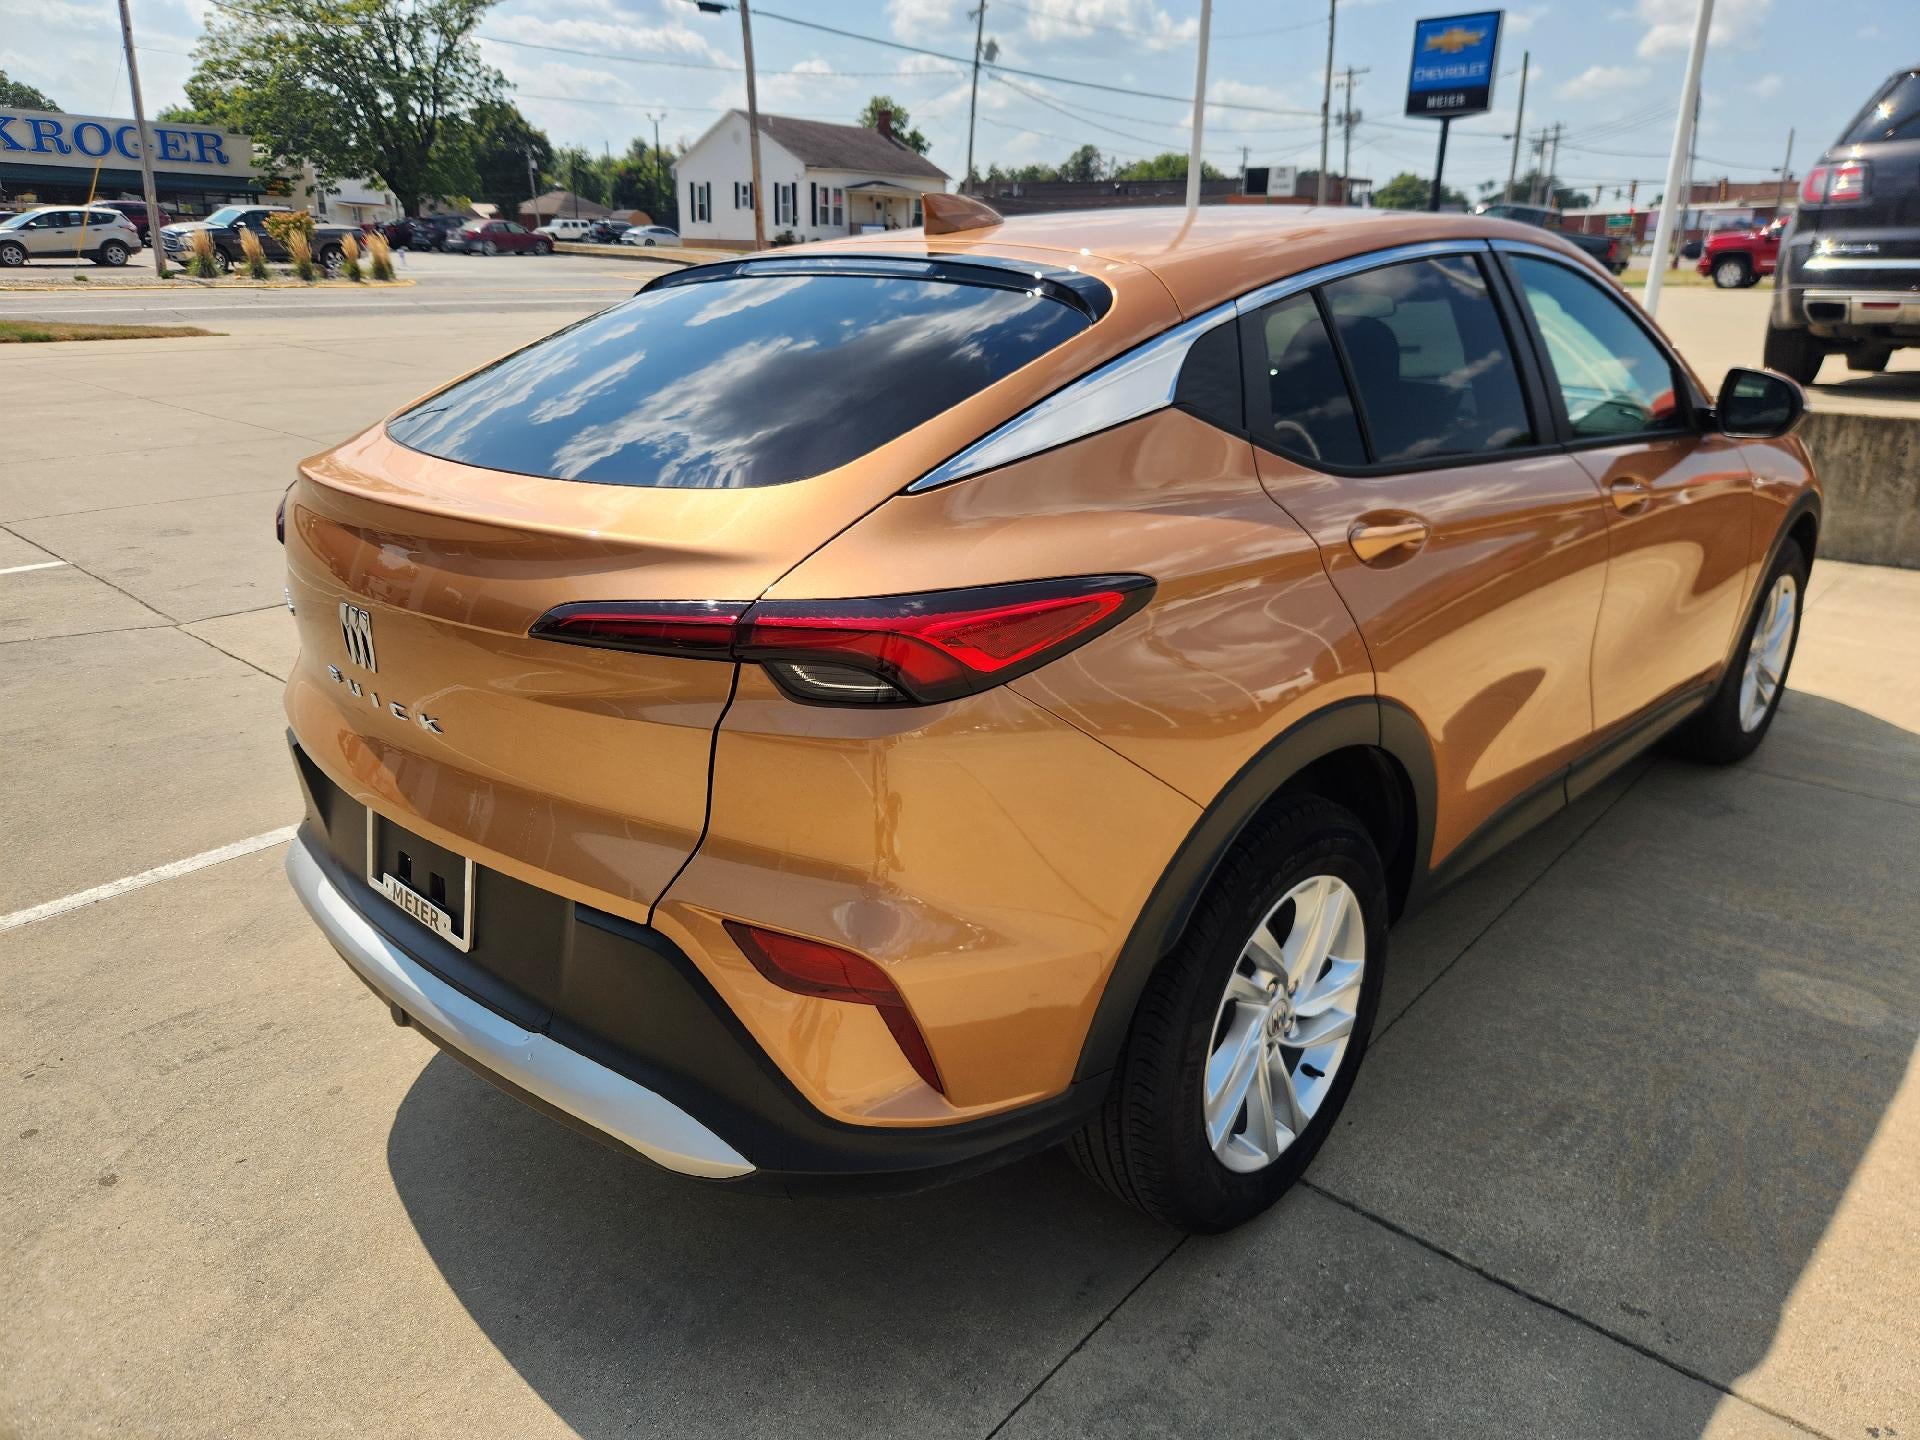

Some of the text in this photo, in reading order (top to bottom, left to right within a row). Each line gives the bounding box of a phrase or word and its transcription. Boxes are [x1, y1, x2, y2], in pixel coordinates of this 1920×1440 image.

[1413, 62, 1487, 81] CHEVROLET
[1426, 93, 1466, 109] MEIER
[0, 116, 230, 165] KROGER
[328, 664, 444, 735] BUICK
[392, 882, 440, 931] MEIER
